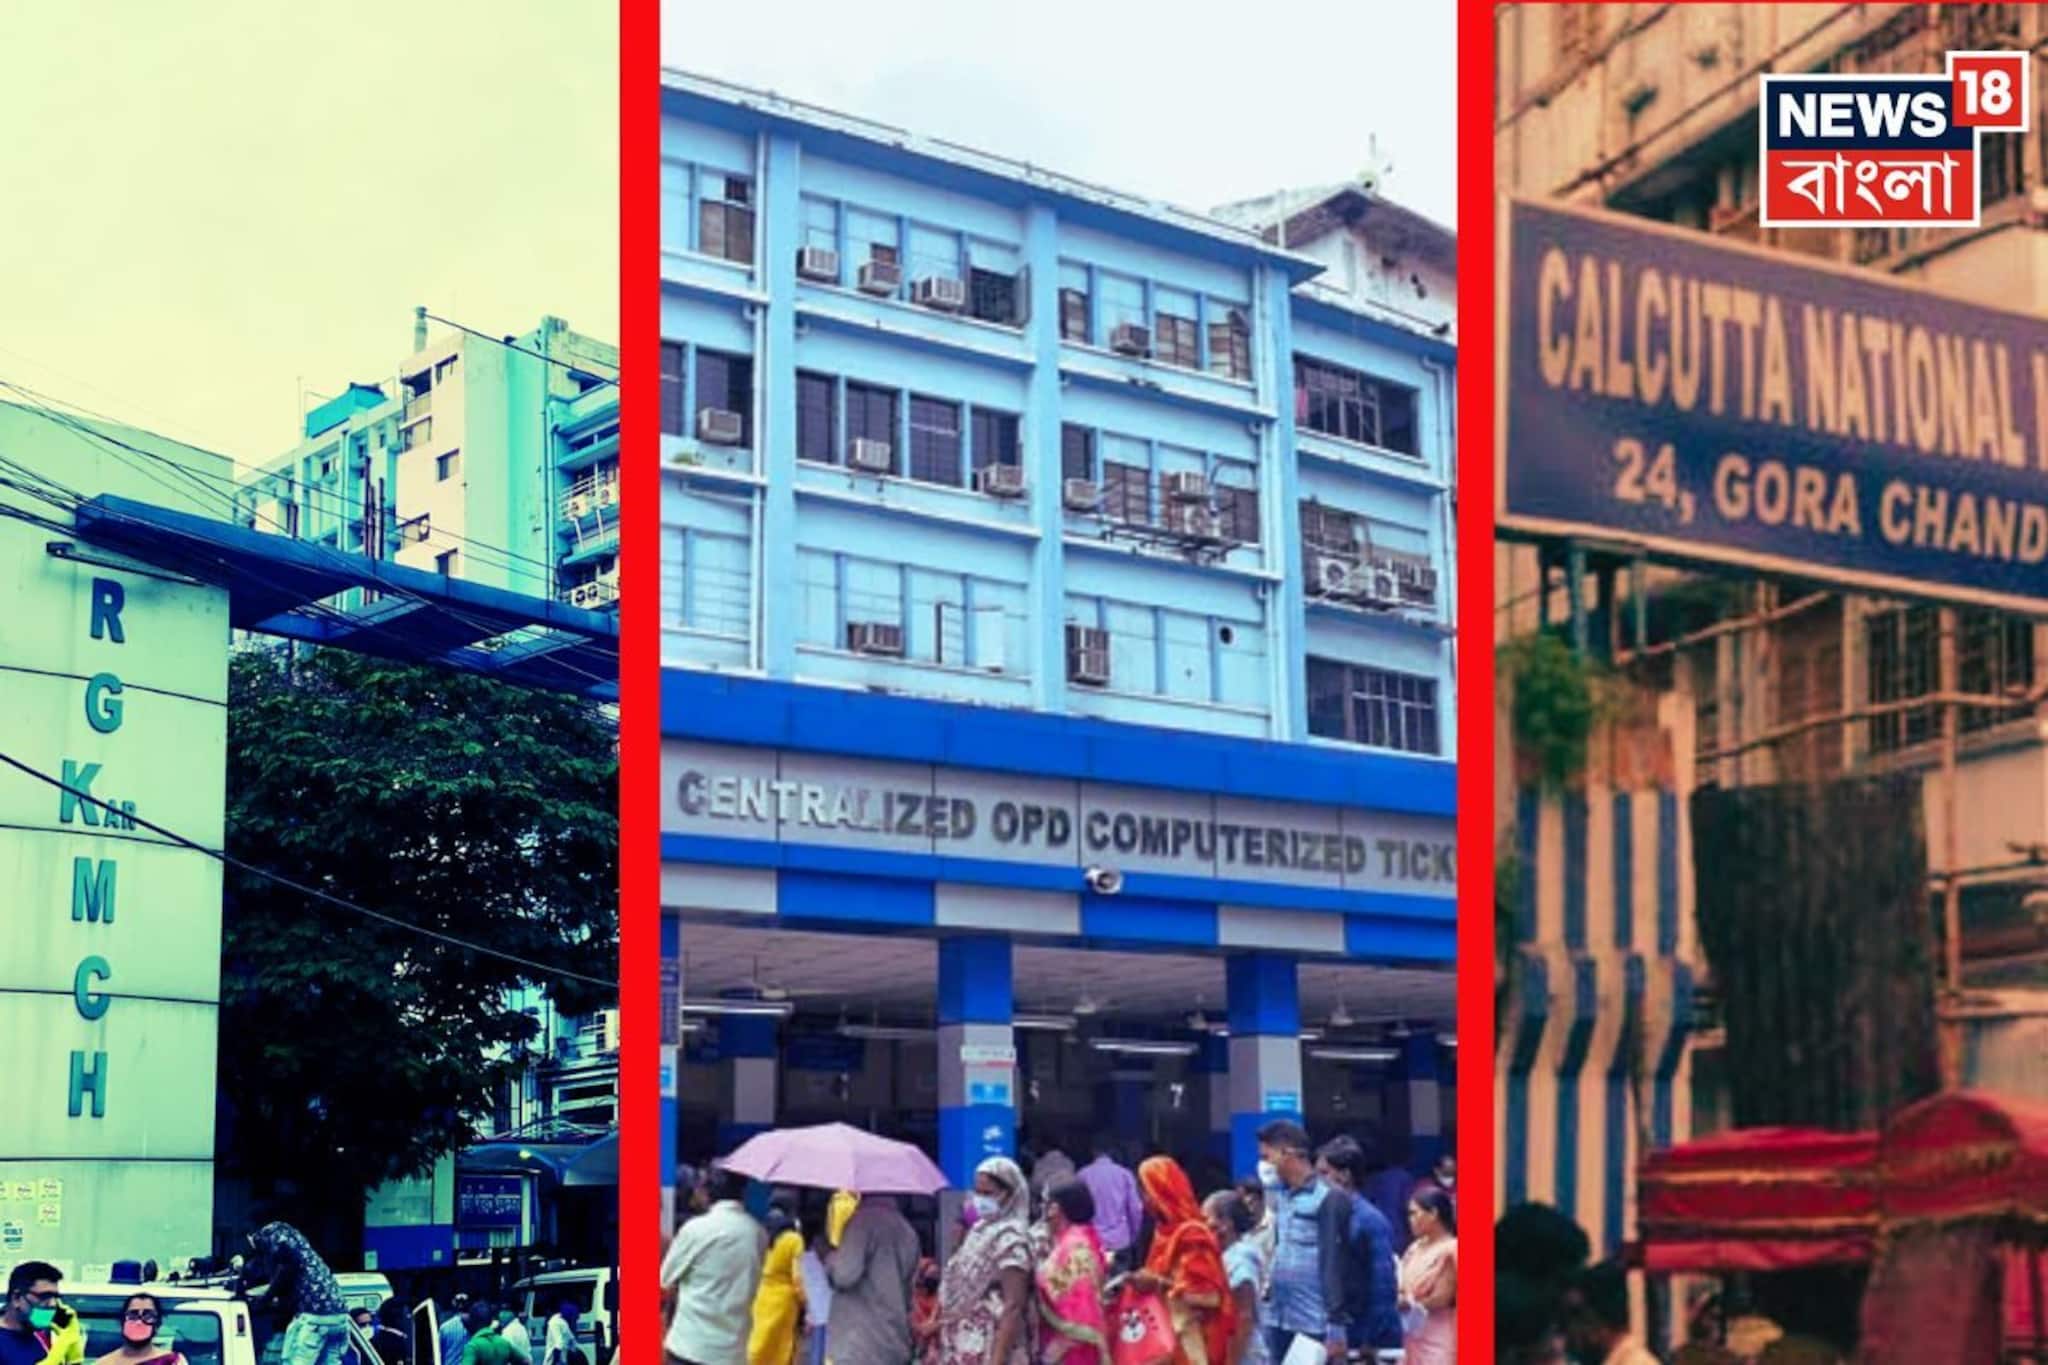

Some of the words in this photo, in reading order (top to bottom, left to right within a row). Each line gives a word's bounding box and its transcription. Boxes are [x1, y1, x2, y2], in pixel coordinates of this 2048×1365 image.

[1537, 247, 1796, 428] CALCUTTA
[1797, 303, 2026, 468] NATIONAL
[1613, 436, 1696, 525] 24,
[1713, 454, 1862, 536] GORA
[1879, 482, 2048, 565] CHAND
[90, 576, 125, 644] R
[85, 672, 124, 734] G
[678, 770, 977, 840] CENTRALIZED
[991, 801, 1071, 849] OPD
[1085, 811, 1367, 875] COMPUTERIZED
[1375, 838, 1457, 883] TICK
[71, 856, 117, 924] M
[74, 955, 112, 1021] C
[68, 1050, 108, 1118] H
